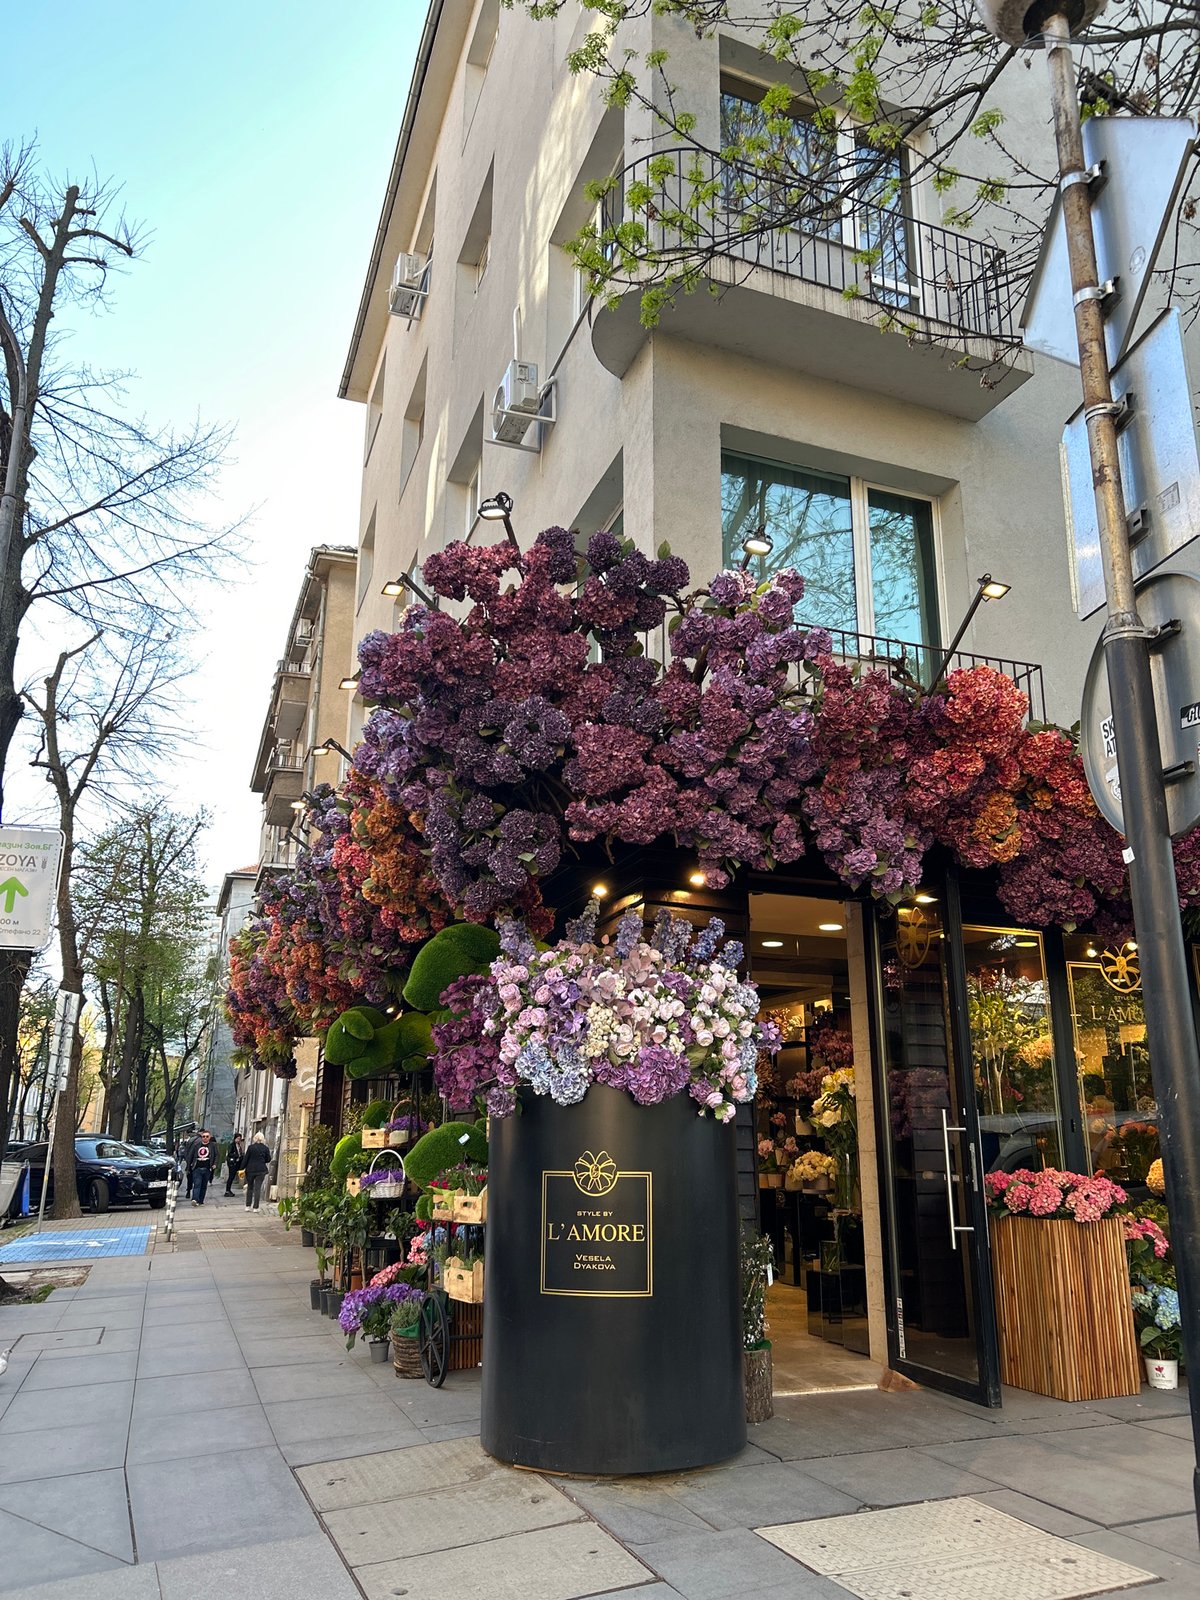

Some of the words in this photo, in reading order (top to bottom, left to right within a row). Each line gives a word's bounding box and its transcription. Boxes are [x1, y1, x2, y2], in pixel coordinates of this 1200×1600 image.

[0, 854, 36, 867] ZOYA
[547, 1222, 646, 1242] L'AMORE
[575, 1253, 612, 1262] VESELA
[573, 1262, 616, 1271] DYAKOVA
